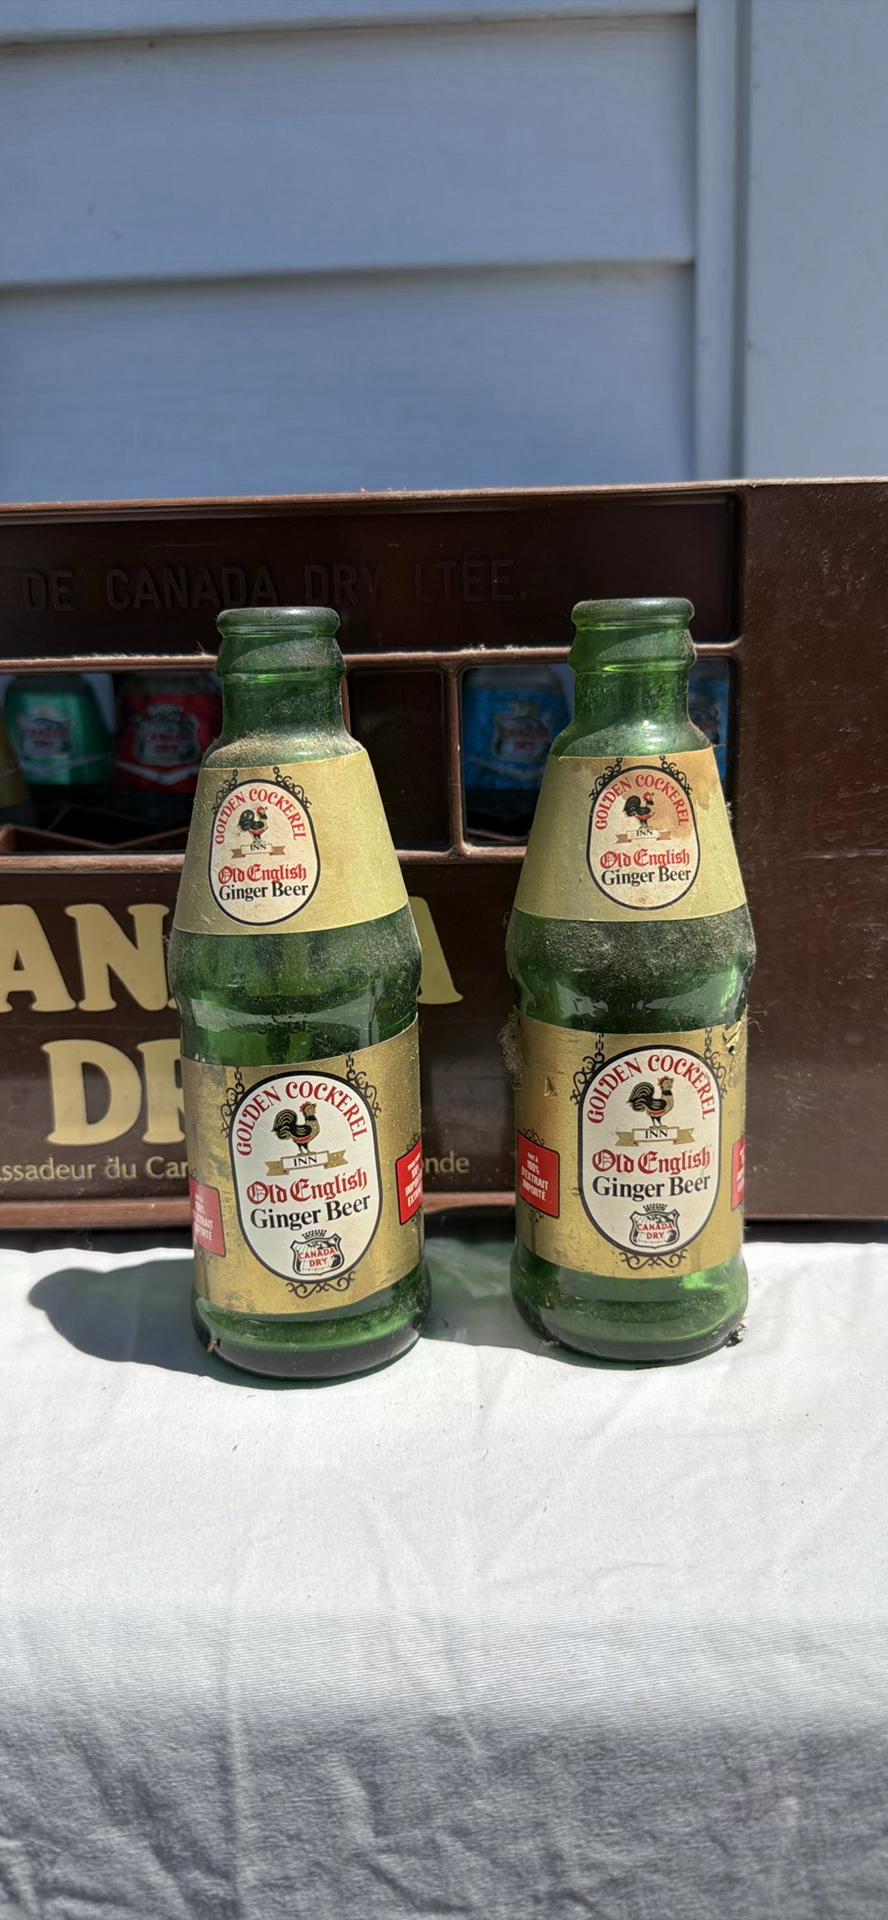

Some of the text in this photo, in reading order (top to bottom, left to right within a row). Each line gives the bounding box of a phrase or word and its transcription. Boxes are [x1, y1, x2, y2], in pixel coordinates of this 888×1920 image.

[22, 566, 76, 613] DE
[105, 562, 280, 611] CANADA
[303, 561, 386, 606] DRY
[594, 774, 689, 830] GOLDEN COCKEREL
[215, 788, 307, 845] GOLDEN COCKEREL
[250, 843, 267, 852] INN
[600, 848, 690, 869] Old English
[218, 863, 307, 885] Old English
[601, 867, 692, 887] Ginger Beer
[219, 881, 308, 902] Ginger Beer
[587, 1054, 716, 1124] GOLDEN COCKEREL
[236, 1081, 368, 1156] GOLDEN COCKEREL
[644, 1130, 668, 1139] INN
[0, 1155, 96, 1182] ssadeur
[105, 1156, 137, 1180] du
[293, 1155, 318, 1167] INN
[421, 1150, 470, 1174] nde
[592, 1148, 634, 1174] Old
[638, 1146, 711, 1175] English
[247, 1167, 368, 1205] Old English
[592, 1175, 711, 1202] Ginger Beer
[250, 1195, 371, 1231] Ginger Beer
[636, 1222, 674, 1232] CANADA
[646, 1231, 665, 1240] DRY
[298, 1247, 336, 1261] CANADA
[309, 1257, 328, 1268] DRY
